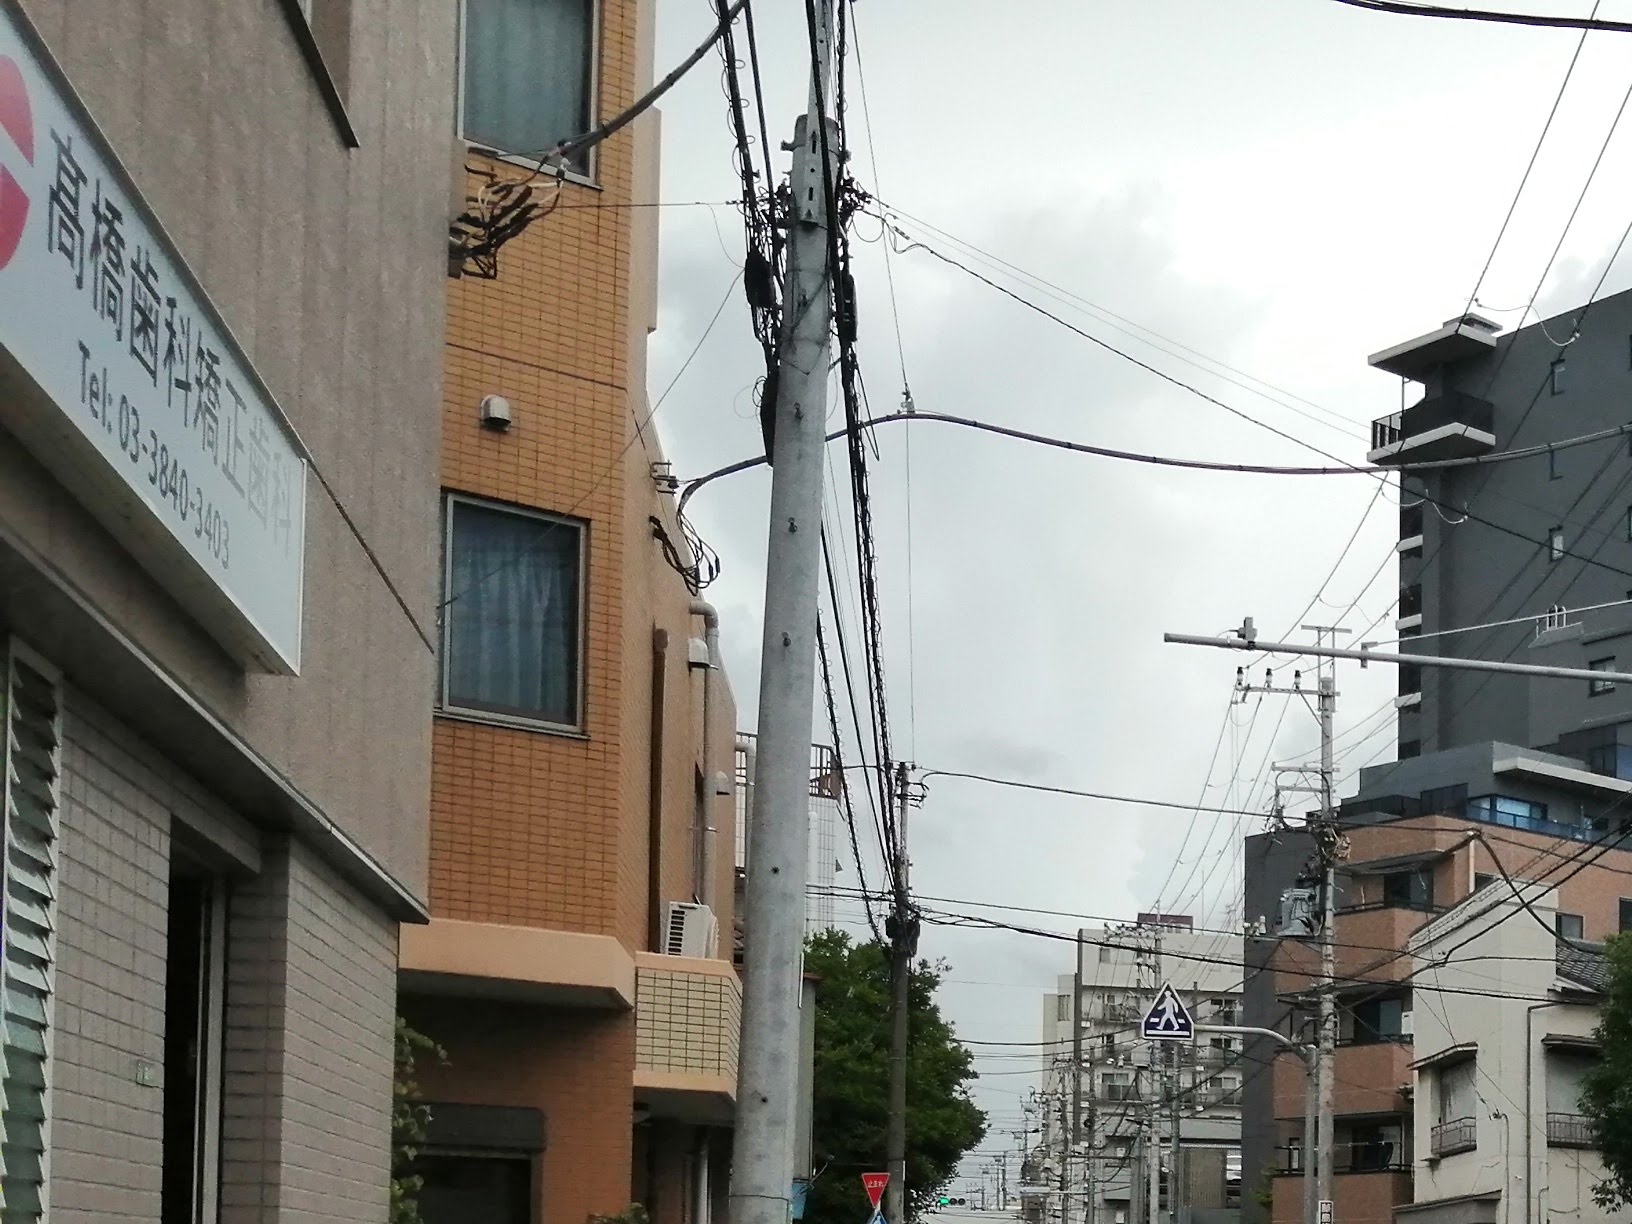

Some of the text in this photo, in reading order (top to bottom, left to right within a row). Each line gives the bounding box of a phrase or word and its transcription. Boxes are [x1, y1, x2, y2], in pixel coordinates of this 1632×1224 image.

[79, 339, 230, 570] Tel: 03-3840-3403
[867, 1180, 884, 1188] 止まれ
